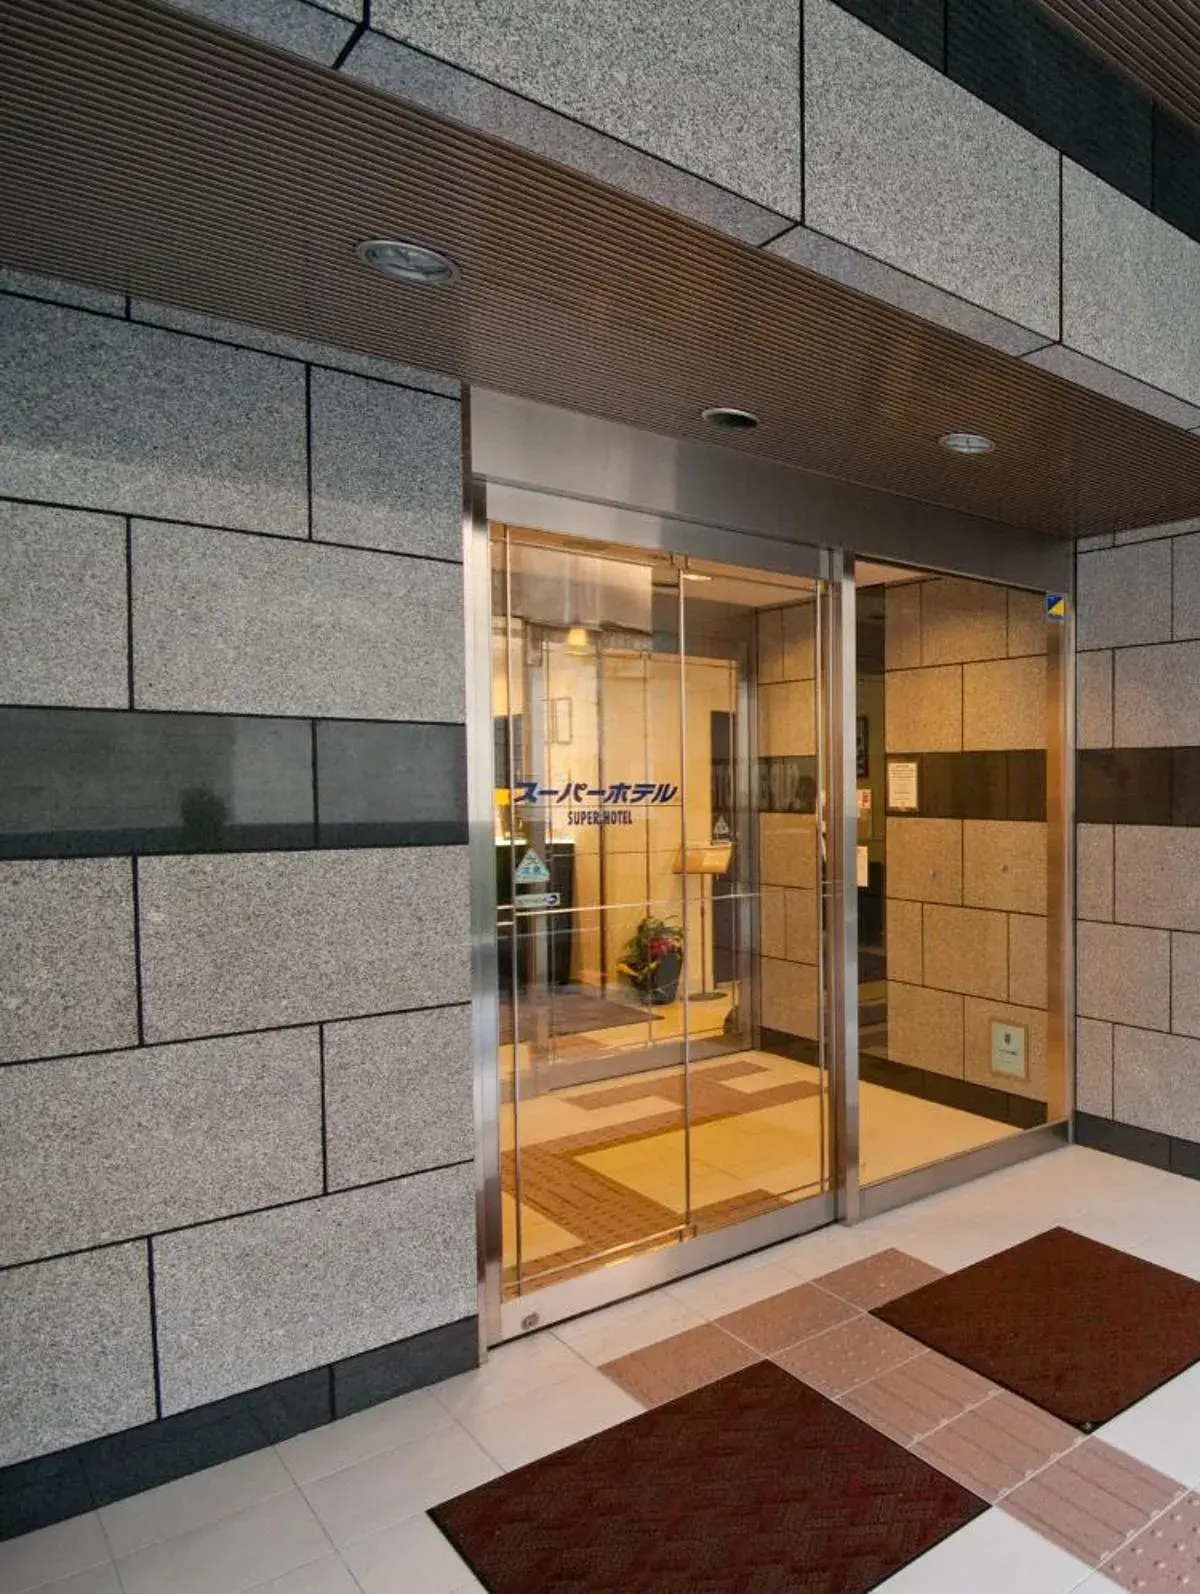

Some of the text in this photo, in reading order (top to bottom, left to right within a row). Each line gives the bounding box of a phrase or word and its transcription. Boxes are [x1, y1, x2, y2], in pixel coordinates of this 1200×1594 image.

[514, 782, 678, 804] スーパーホテル
[567, 811, 633, 825] SUPER HOTEL
